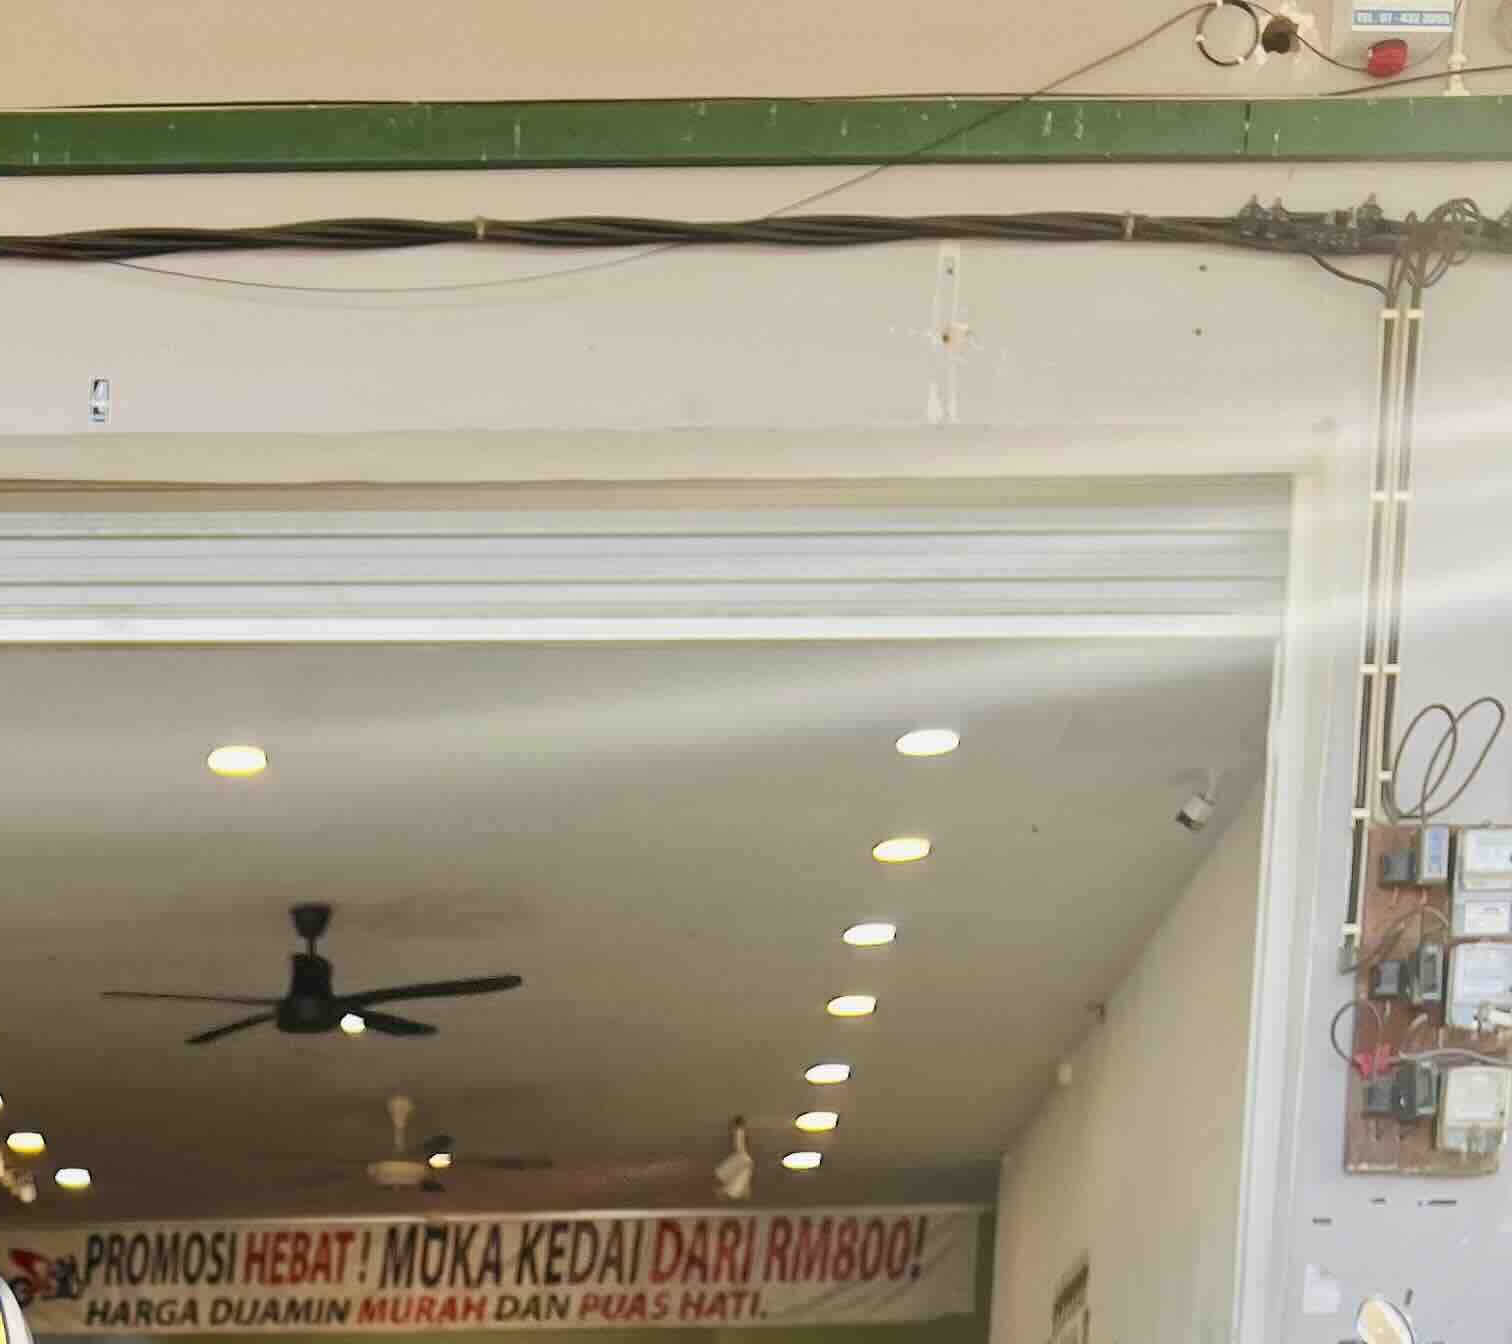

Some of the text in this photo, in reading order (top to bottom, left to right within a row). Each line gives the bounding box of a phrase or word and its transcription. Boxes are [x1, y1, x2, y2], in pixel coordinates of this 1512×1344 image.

[86, 1231, 238, 1285] PROMOSI
[516, 1219, 645, 1286] KEDAI
[648, 1217, 758, 1283] DARI
[763, 1214, 927, 1282] RM800!
[85, 1298, 199, 1326] HARGA
[356, 1295, 488, 1324] MURAH
[494, 1294, 571, 1322] DAN
[579, 1292, 670, 1320] PUAS
[679, 1290, 768, 1321] HATI.
